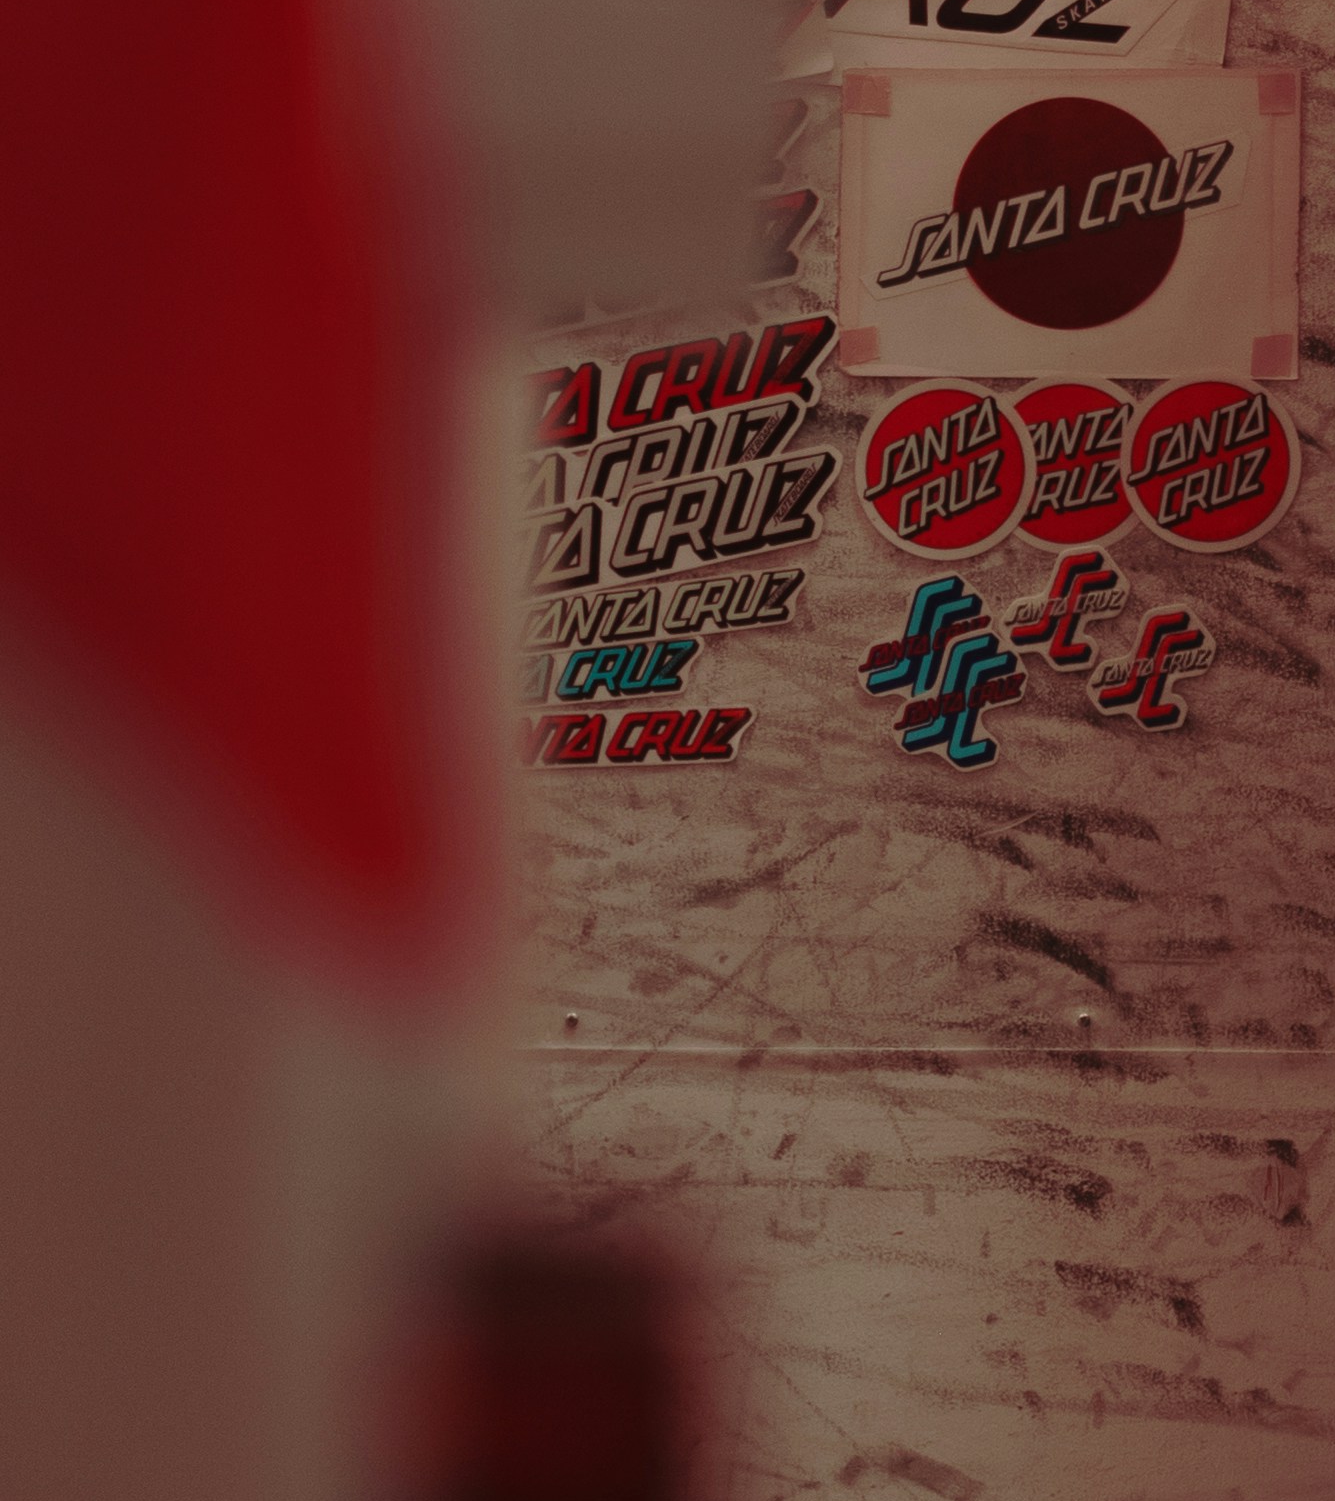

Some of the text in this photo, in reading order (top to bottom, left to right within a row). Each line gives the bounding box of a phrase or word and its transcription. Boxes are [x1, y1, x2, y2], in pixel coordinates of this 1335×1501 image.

[877, 184, 1071, 289] SANTA
[1078, 140, 1234, 230] CRUZ
[607, 315, 837, 433] CRUZ
[864, 395, 1001, 502] SANTA
[1026, 403, 1134, 465] ANTA
[1127, 392, 1270, 486] SANTA
[609, 451, 837, 579] CRUZ
[898, 449, 1004, 541] CRUZ
[1024, 461, 1122, 522] RUZ
[1156, 447, 1270, 530] CRUZ
[526, 586, 662, 650] ANTA
[662, 568, 806, 634] CRUZ
[1004, 590, 1125, 627] SANTA CRUZ
[555, 637, 704, 701] CRUZ
[858, 633, 931, 673] SANTA
[1091, 649, 1213, 689] SANTA CRUZ
[606, 706, 753, 762] CRUZ
[894, 672, 1027, 731] SANTA CRUZ
